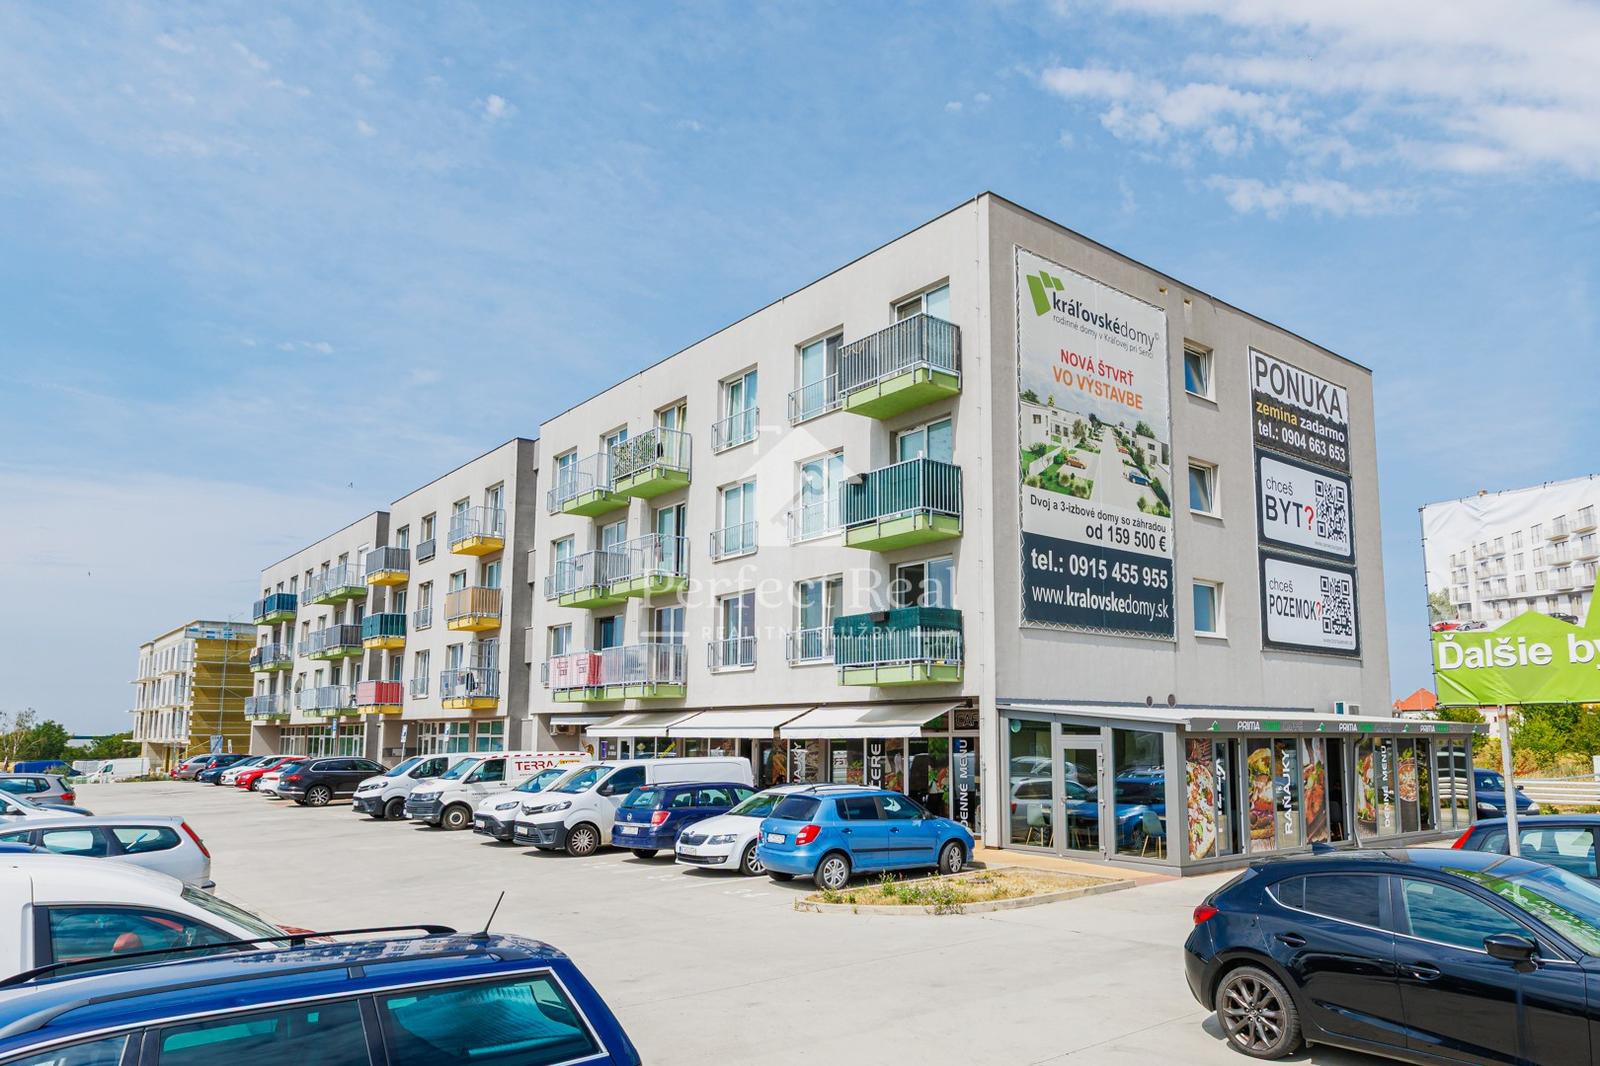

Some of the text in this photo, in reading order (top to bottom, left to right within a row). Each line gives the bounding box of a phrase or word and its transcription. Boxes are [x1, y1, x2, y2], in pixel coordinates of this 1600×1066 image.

[1053, 315, 1078, 330] rodinné
[1080, 324, 1098, 339] domy
[1129, 344, 1138, 352] pri
[1060, 349, 1135, 386] NOVÁ ŠTVRŤ
[1053, 366, 1143, 410] VO VÝSTAVBE
[1255, 355, 1343, 420] PONUKA
[1256, 401, 1345, 443] zemina zadarmo
[1258, 419, 1346, 463] tel.: 0904 663 653
[1266, 476, 1294, 496] chceš
[1030, 494, 1167, 533] Dvoj a 3-izbové domy so záhradou
[1265, 494, 1315, 531] BYT?
[1085, 523, 1167, 552] od 159 500 €
[1031, 547, 1169, 590] tel.: 0915 455 955
[1268, 576, 1294, 593] chceš
[1032, 585, 1169, 622] www.kralovskedomy.sk
[1269, 594, 1322, 621] POZEMOK?
[1438, 634, 1553, 670] Ďalšie
[1236, 720, 1261, 731] PRIMA
[1338, 722, 1358, 732] PRIMA
[1420, 724, 1436, 733] PRIMA
[515, 759, 554, 771] TERRA
[959, 739, 968, 779] MENU
[1380, 745, 1388, 782] MENU
[1281, 749, 1293, 835] RAŇAJKY
